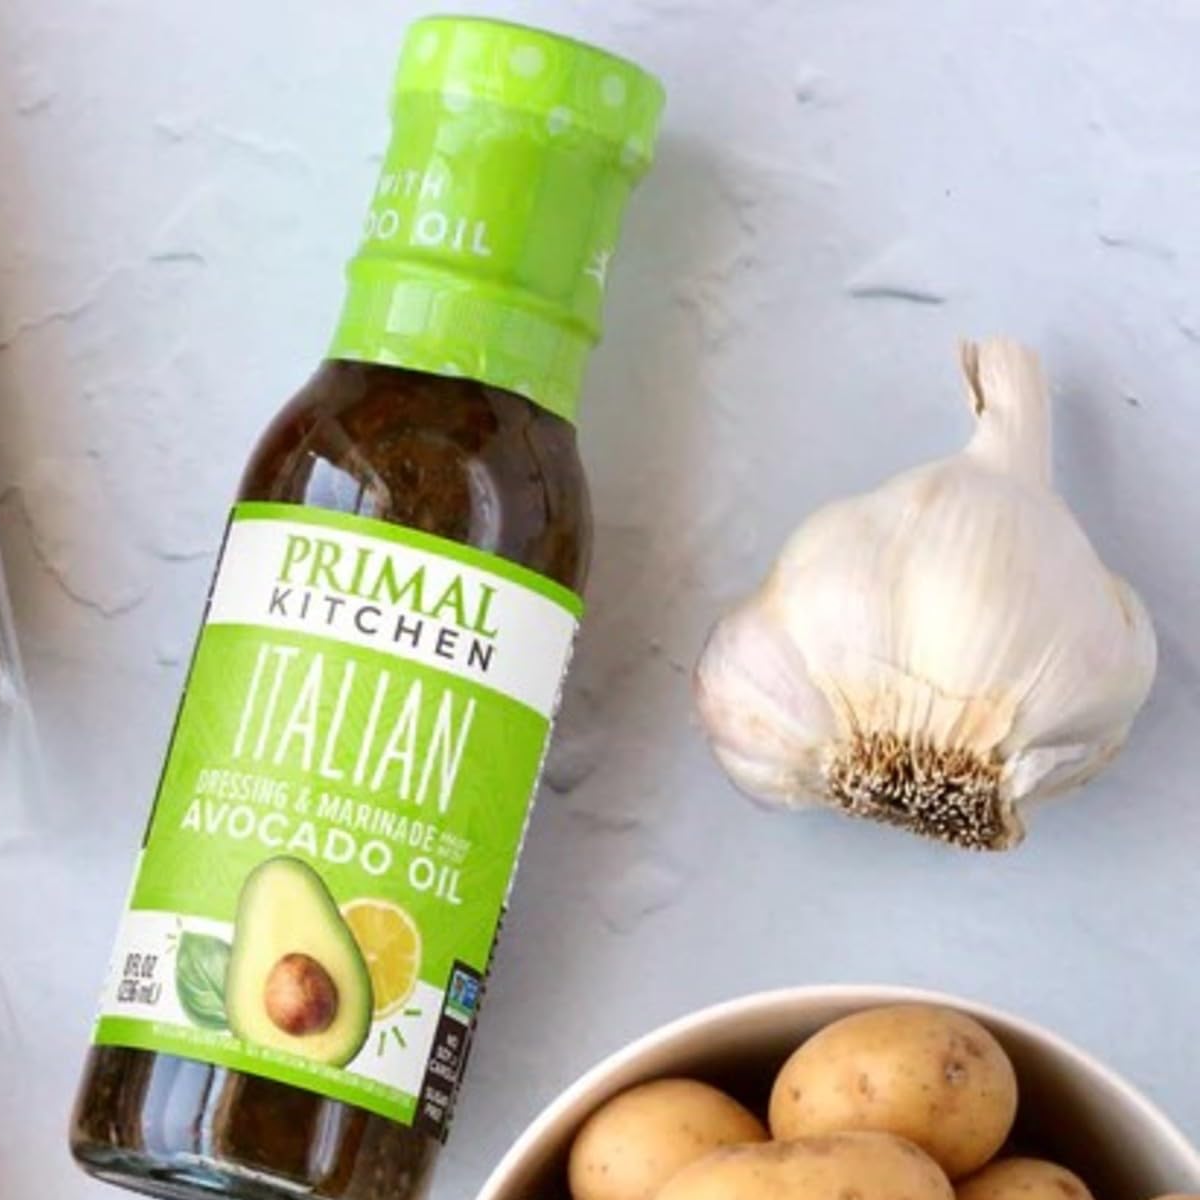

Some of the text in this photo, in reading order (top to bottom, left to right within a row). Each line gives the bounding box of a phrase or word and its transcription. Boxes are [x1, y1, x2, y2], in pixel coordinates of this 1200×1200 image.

[415, 210, 492, 256] OIL
[268, 587, 496, 672] KITCHEN
[277, 534, 498, 638] PRIMAL
[232, 643, 476, 814] ITALIAN
[181, 798, 393, 875] AVOCADO
[408, 857, 463, 905] OIL
[195, 769, 289, 809] DRESSING
[295, 787, 312, 813] &
[317, 793, 438, 851] MARINADE
